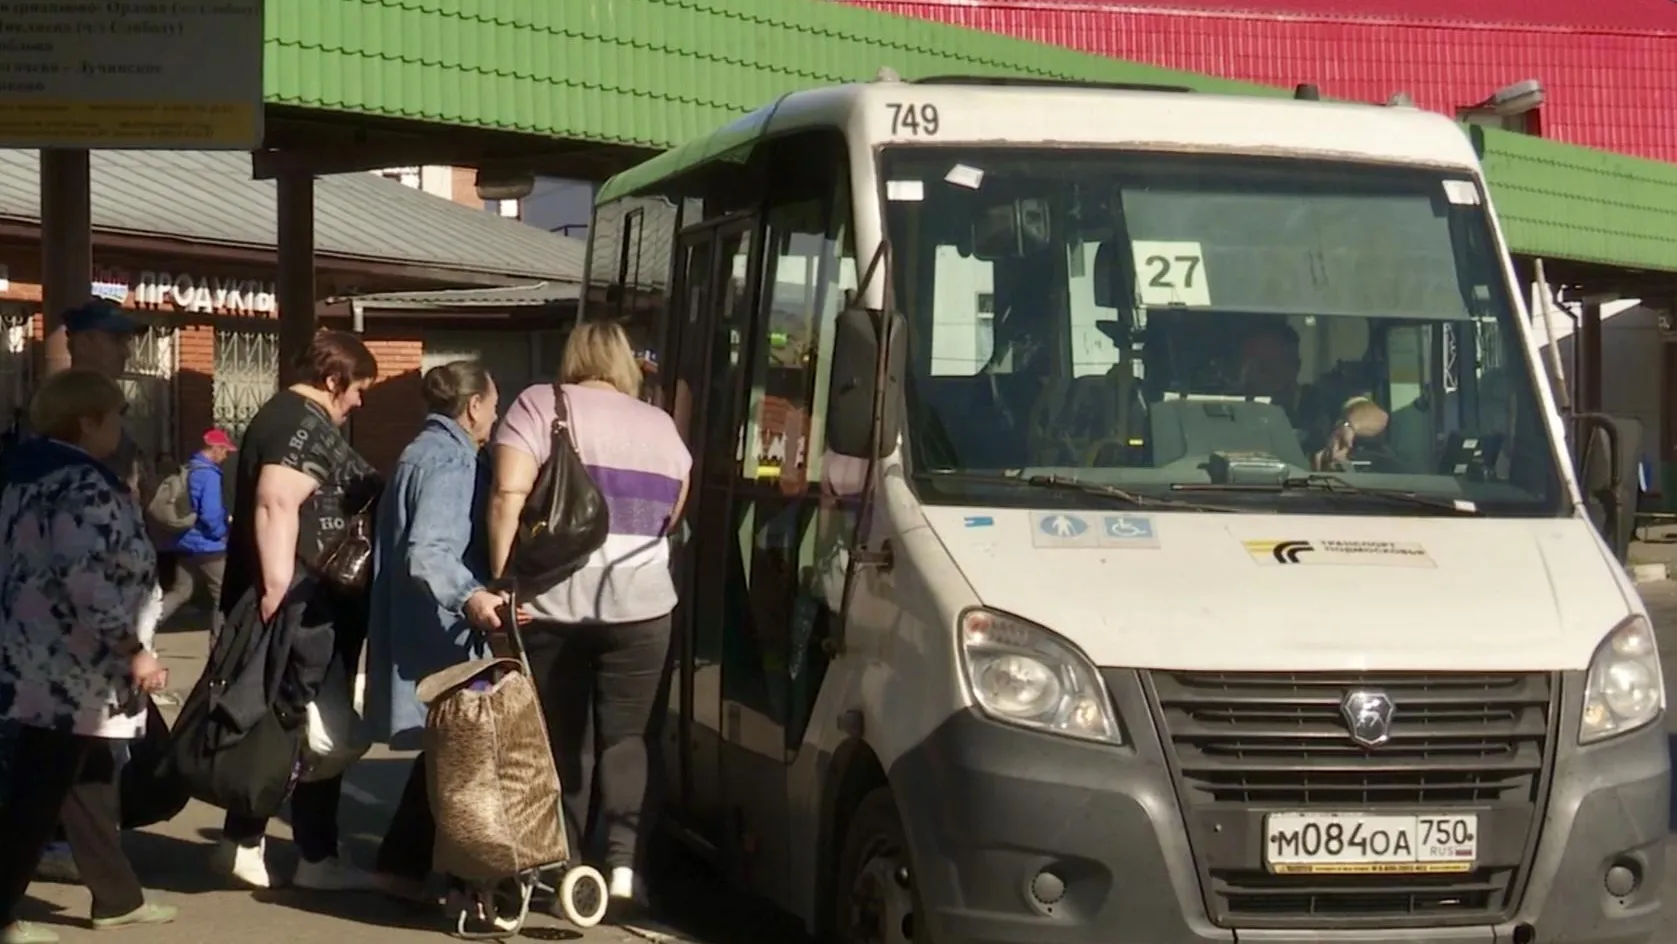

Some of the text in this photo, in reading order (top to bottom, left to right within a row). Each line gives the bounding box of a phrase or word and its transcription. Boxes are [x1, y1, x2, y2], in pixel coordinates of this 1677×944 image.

[885, 103, 940, 136] 749
[1143, 254, 1201, 289] 27
[135, 271, 278, 314] ПРОДУКТЫ
[1320, 539, 1395, 549] ТРАНСПОРТ
[1324, 546, 1426, 556] ПОДМОСКОВЬЯ
[1277, 819, 1468, 857] М084ОА 750
[1429, 846, 1456, 857] RUS
